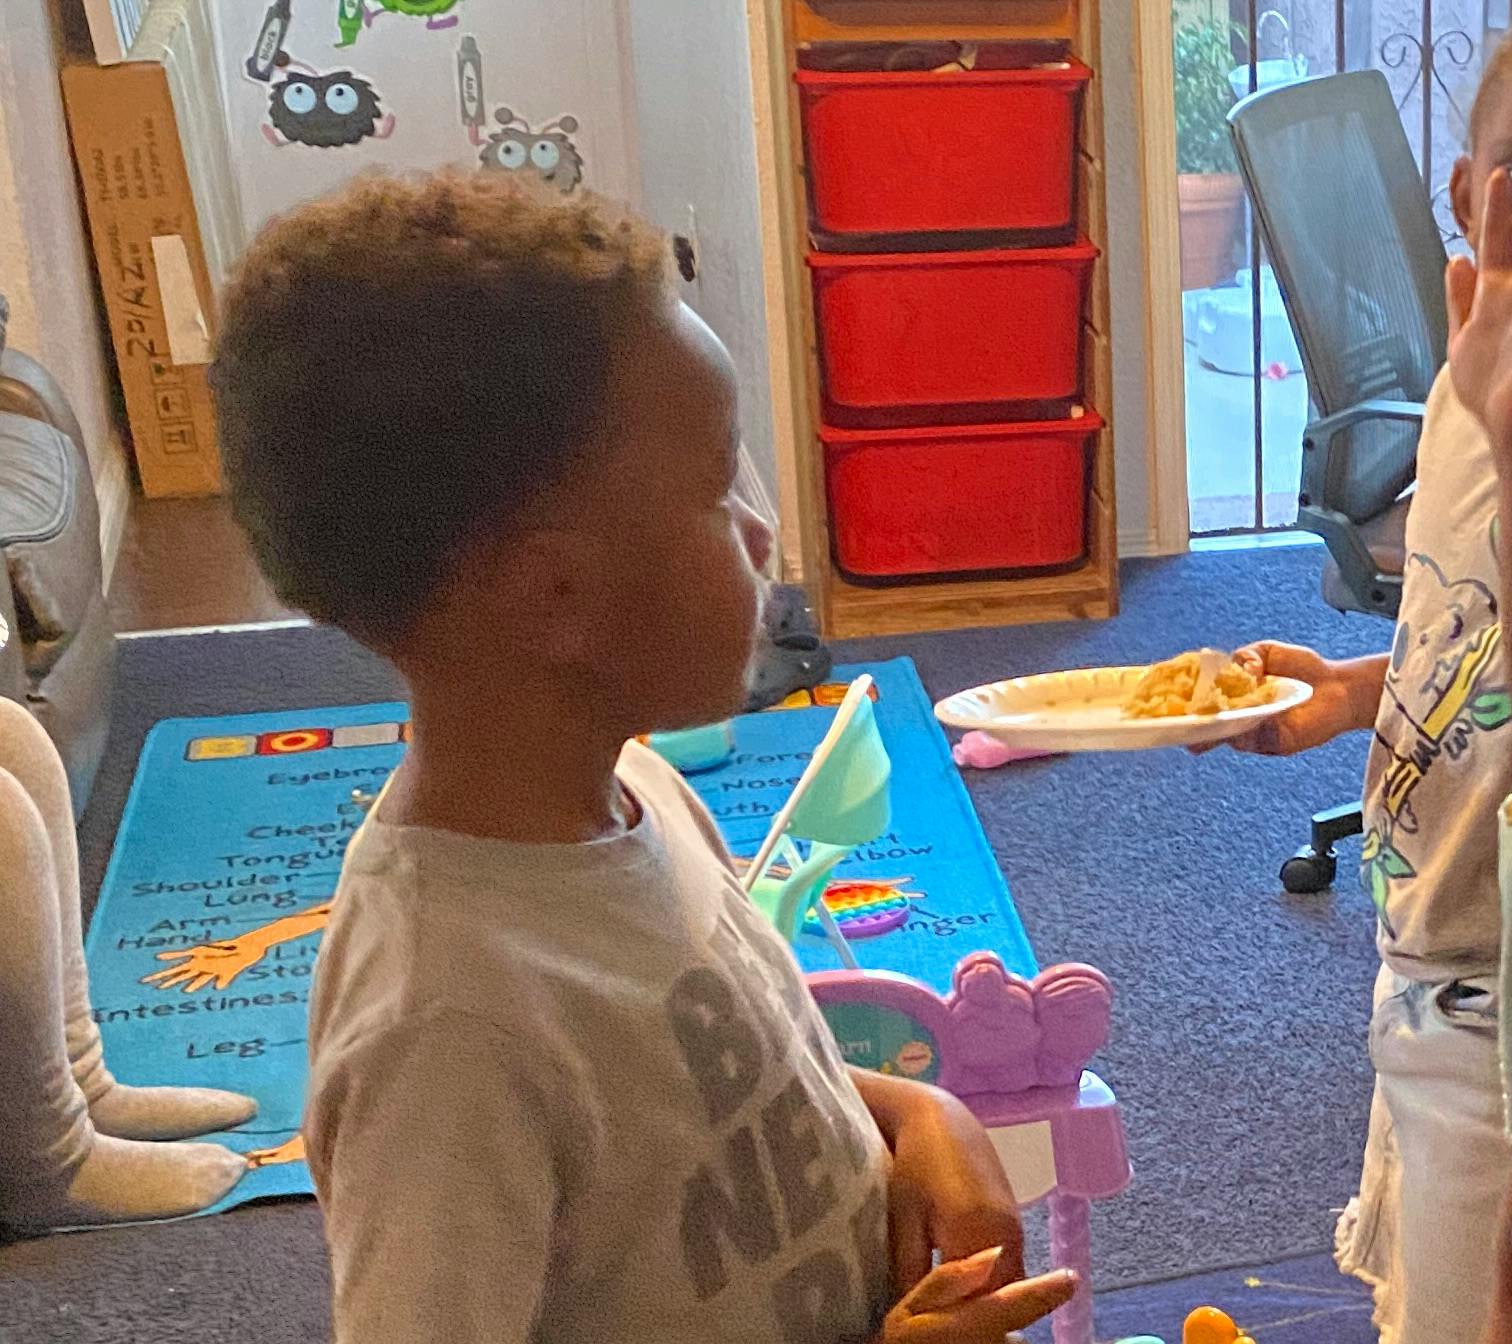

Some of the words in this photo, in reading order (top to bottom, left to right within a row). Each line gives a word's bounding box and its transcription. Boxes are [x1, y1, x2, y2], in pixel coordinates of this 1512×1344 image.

[259, 30, 277, 61] black
[839, 845, 934, 864] lbow
[131, 872, 301, 897] Shoulder
[203, 889, 299, 908] Lung
[149, 914, 232, 933] Arm
[117, 929, 212, 950] Hand
[93, 989, 298, 1024] Intestines
[186, 1036, 267, 1060] Leg
